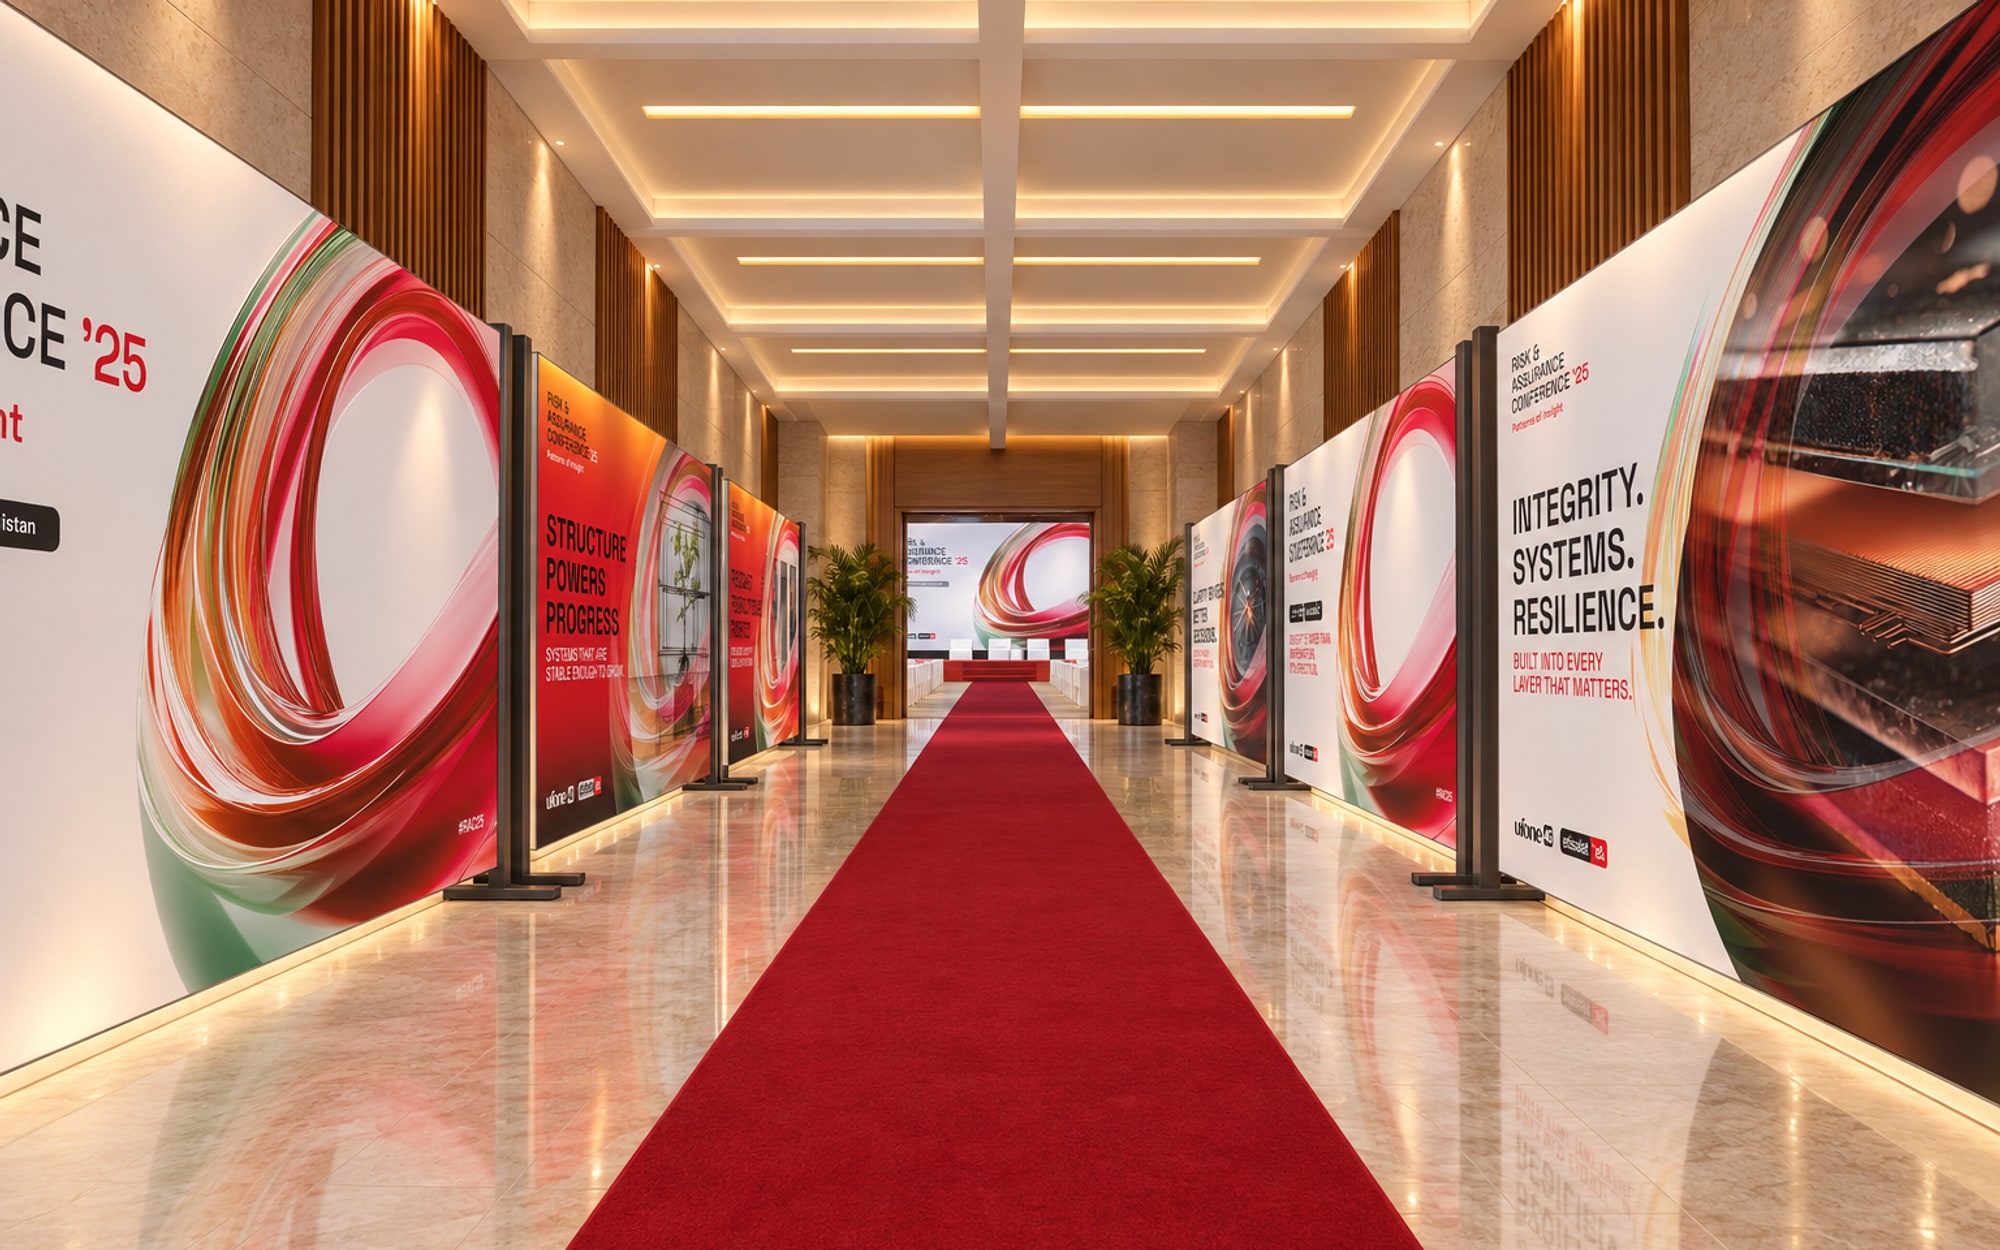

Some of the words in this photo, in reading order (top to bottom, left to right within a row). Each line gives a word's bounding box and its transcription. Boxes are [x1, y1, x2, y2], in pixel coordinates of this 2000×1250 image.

[82, 317, 147, 393] '25
[1572, 361, 1589, 385] '25
[1513, 462, 1644, 535] INTEGRITY.
[546, 513, 627, 563] STRUCTURE
[1513, 527, 1634, 585] SYSTEMS.
[546, 557, 606, 597] POWERS
[546, 601, 620, 636] PROGRESS
[1514, 584, 1665, 636] RESILIENCE.
[1513, 651, 1538, 670] BUILT
[1541, 651, 1564, 671] INTO
[1567, 651, 1603, 672] EVERY
[1513, 675, 1541, 694] LAYER
[1544, 675, 1570, 697] THAT
[1572, 677, 1633, 700] MATTERS.
